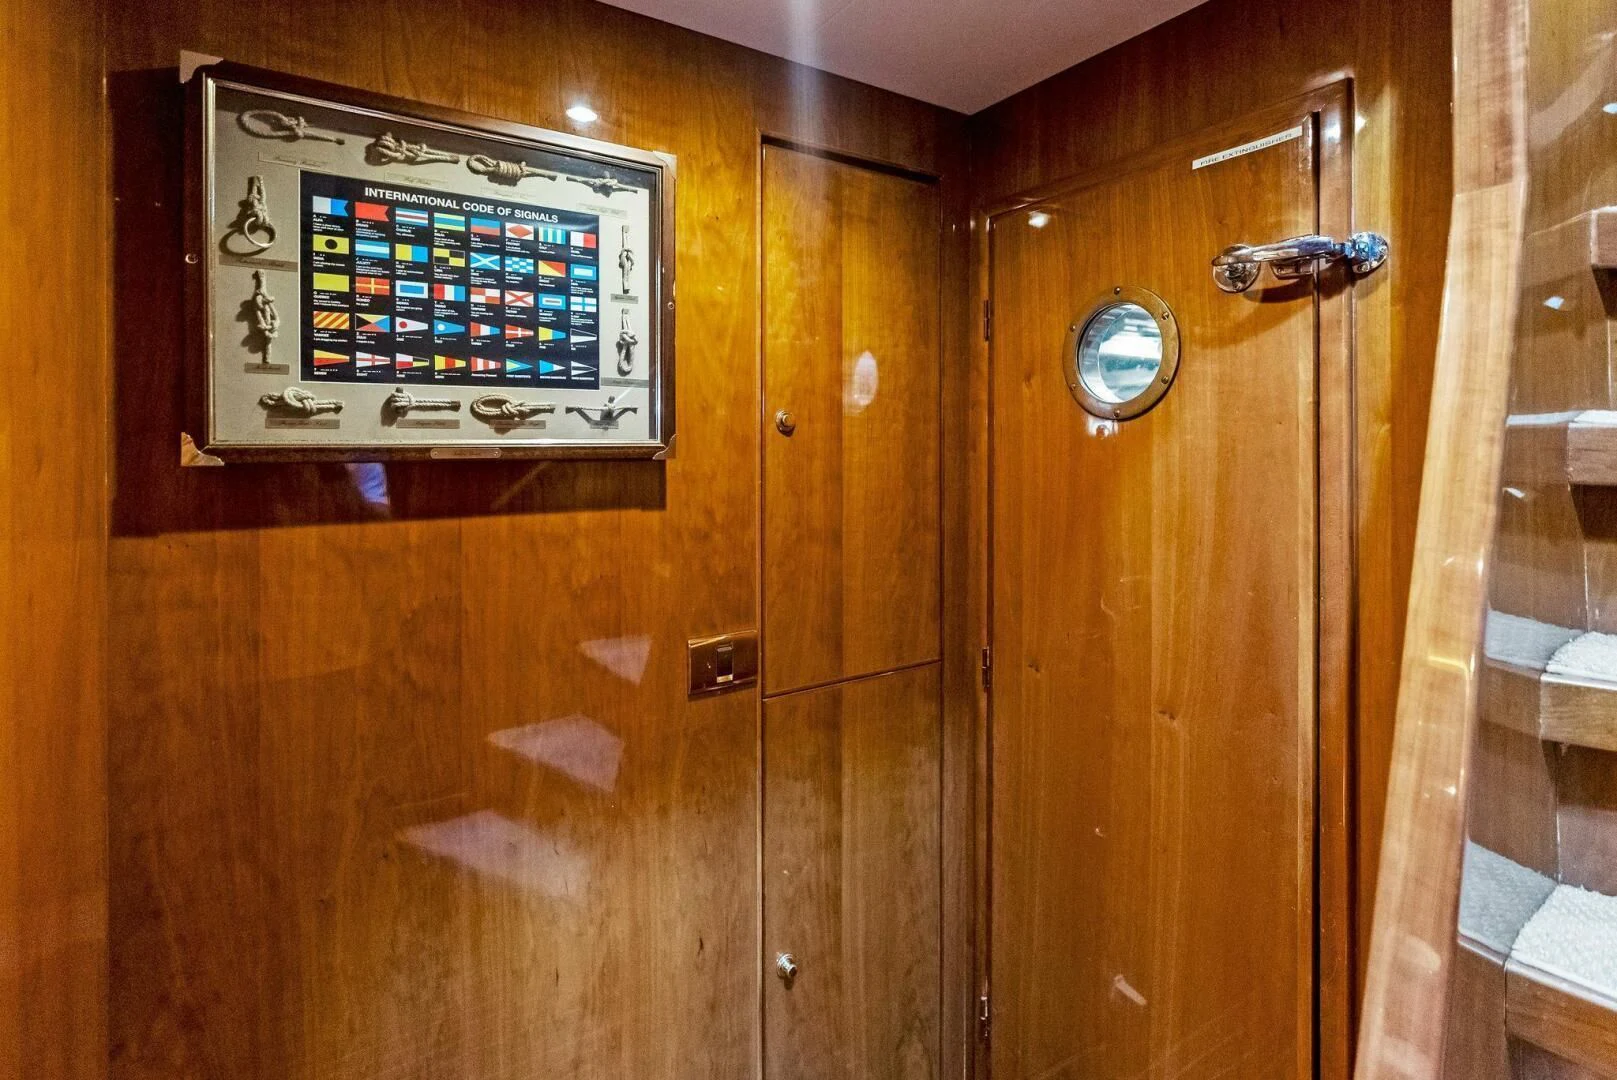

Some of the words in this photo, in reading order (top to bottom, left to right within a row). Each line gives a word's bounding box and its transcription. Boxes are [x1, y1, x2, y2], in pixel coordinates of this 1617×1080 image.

[1200, 156, 1219, 166] FIRE
[1222, 133, 1292, 160] EXTINGUISHER
[365, 187, 460, 209] INTERNATIONAL
[463, 202, 495, 214] CODE
[497, 206, 512, 216] OF
[514, 209, 559, 223] SIGNALS
